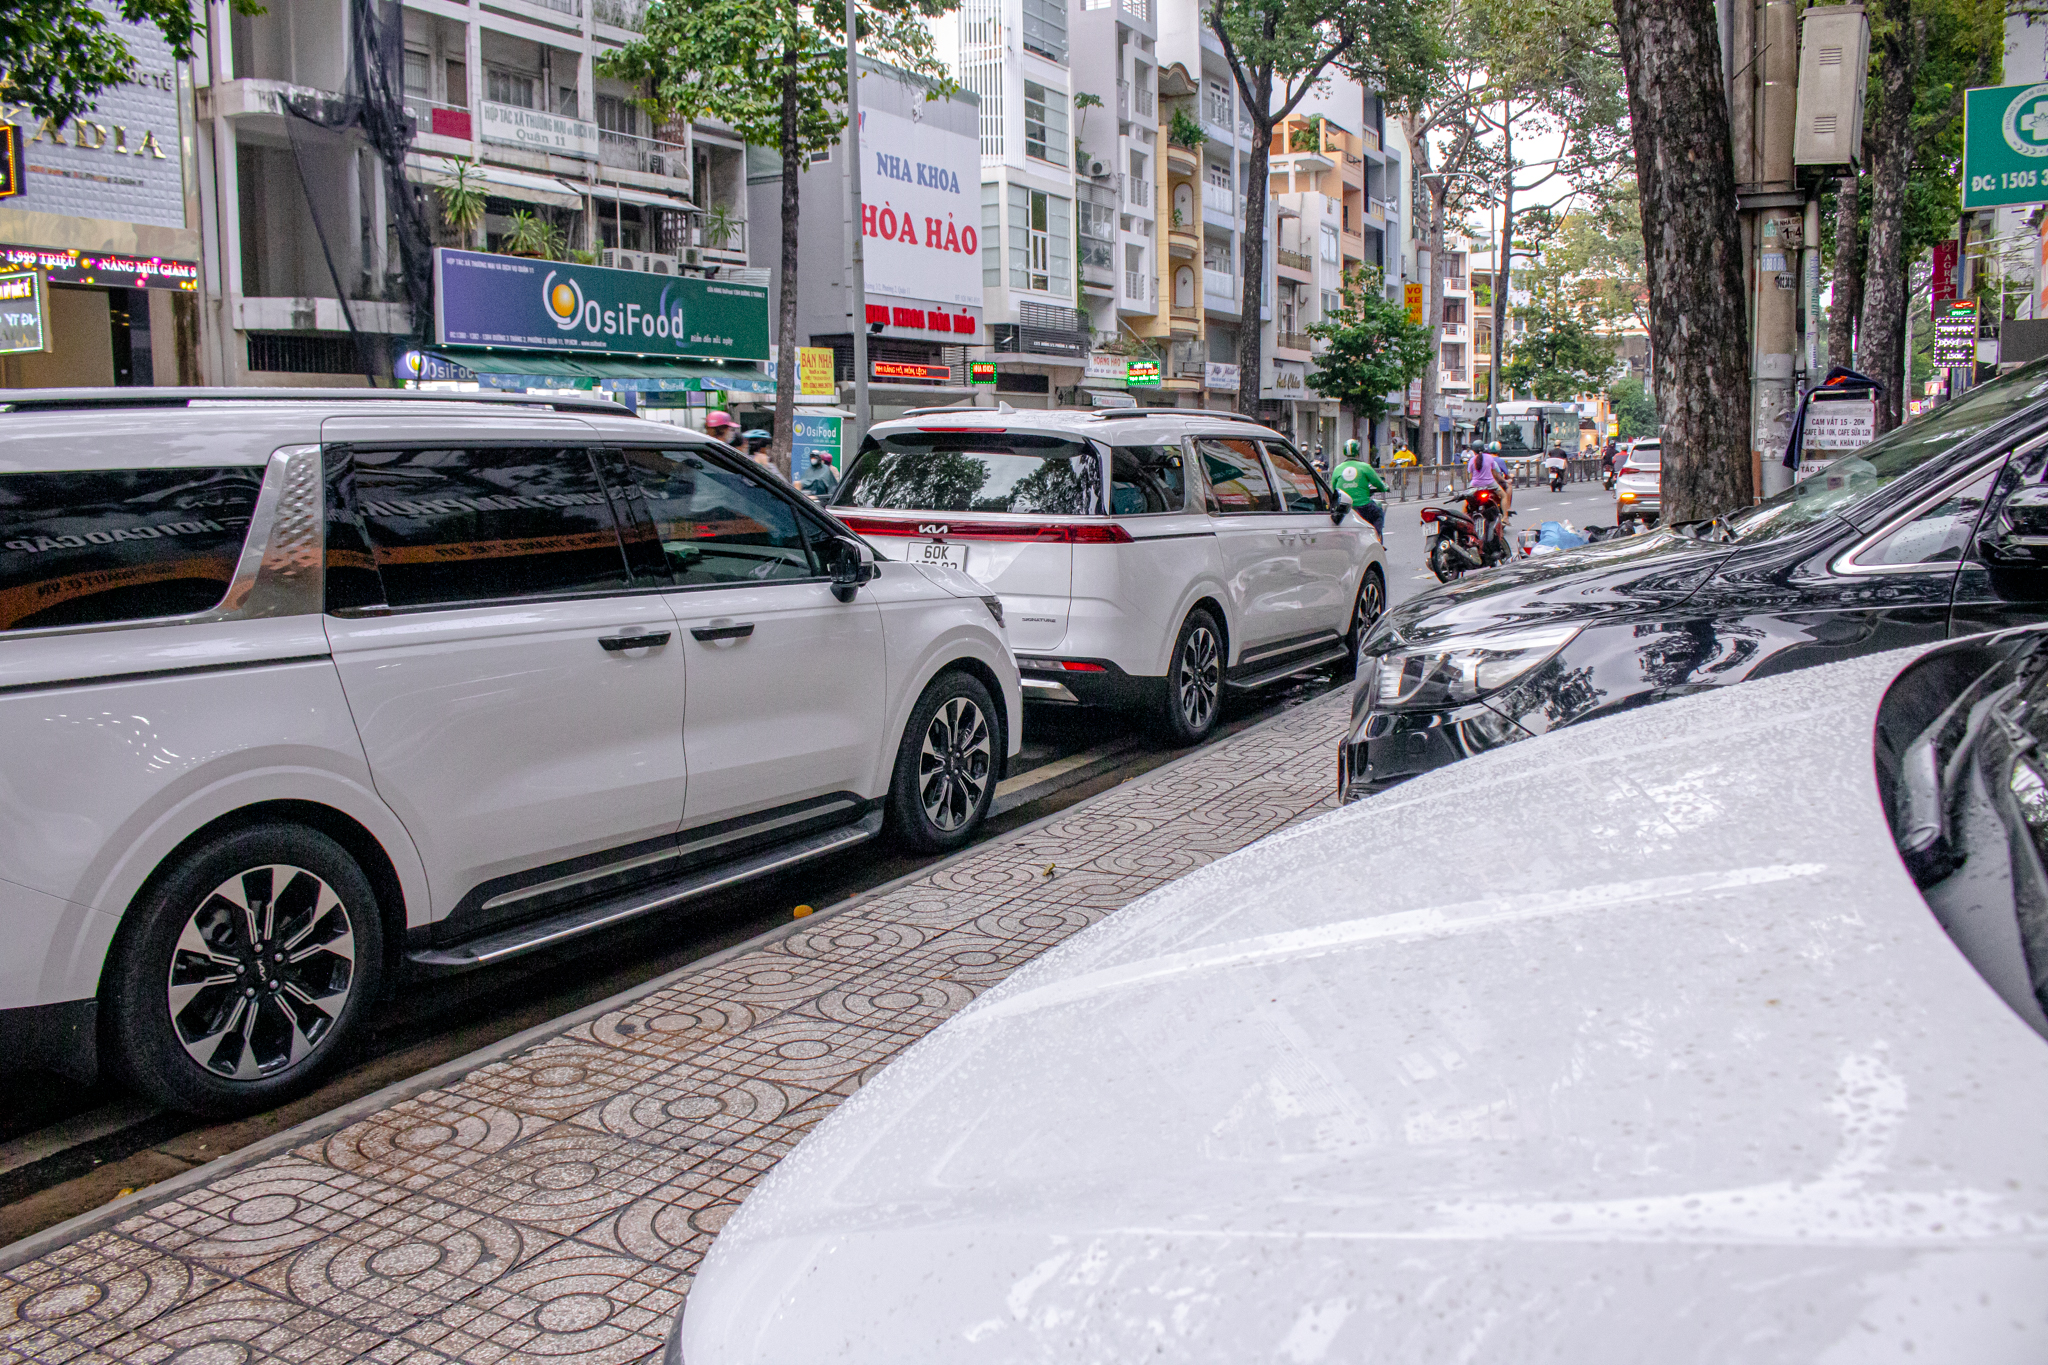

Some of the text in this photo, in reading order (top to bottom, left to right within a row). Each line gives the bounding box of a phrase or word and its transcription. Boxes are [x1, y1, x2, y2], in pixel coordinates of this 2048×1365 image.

[555, 135, 566, 147] 11
[876, 152, 961, 194] NHA KHOA
[1971, 175, 1996, 192] ĐC:
[2001, 169, 2037, 190] 1505
[861, 201, 978, 255] HÒA HẢO
[1795, 226, 1802, 237] 4
[1407, 296, 1421, 304] XE
[585, 300, 684, 340] OsiFood
[865, 304, 976, 335] NHA KHOA HÒA HẢO
[801, 350, 832, 368] BÁN NHÀ
[428, 361, 478, 379] OsiFoo
[1840, 418, 1848, 426] 15
[1853, 418, 1866, 426] 20K
[806, 425, 837, 438] OsiFood
[1805, 428, 1817, 436] CAFE
[918, 524, 948, 534] KIA
[924, 545, 948, 560] 60K
